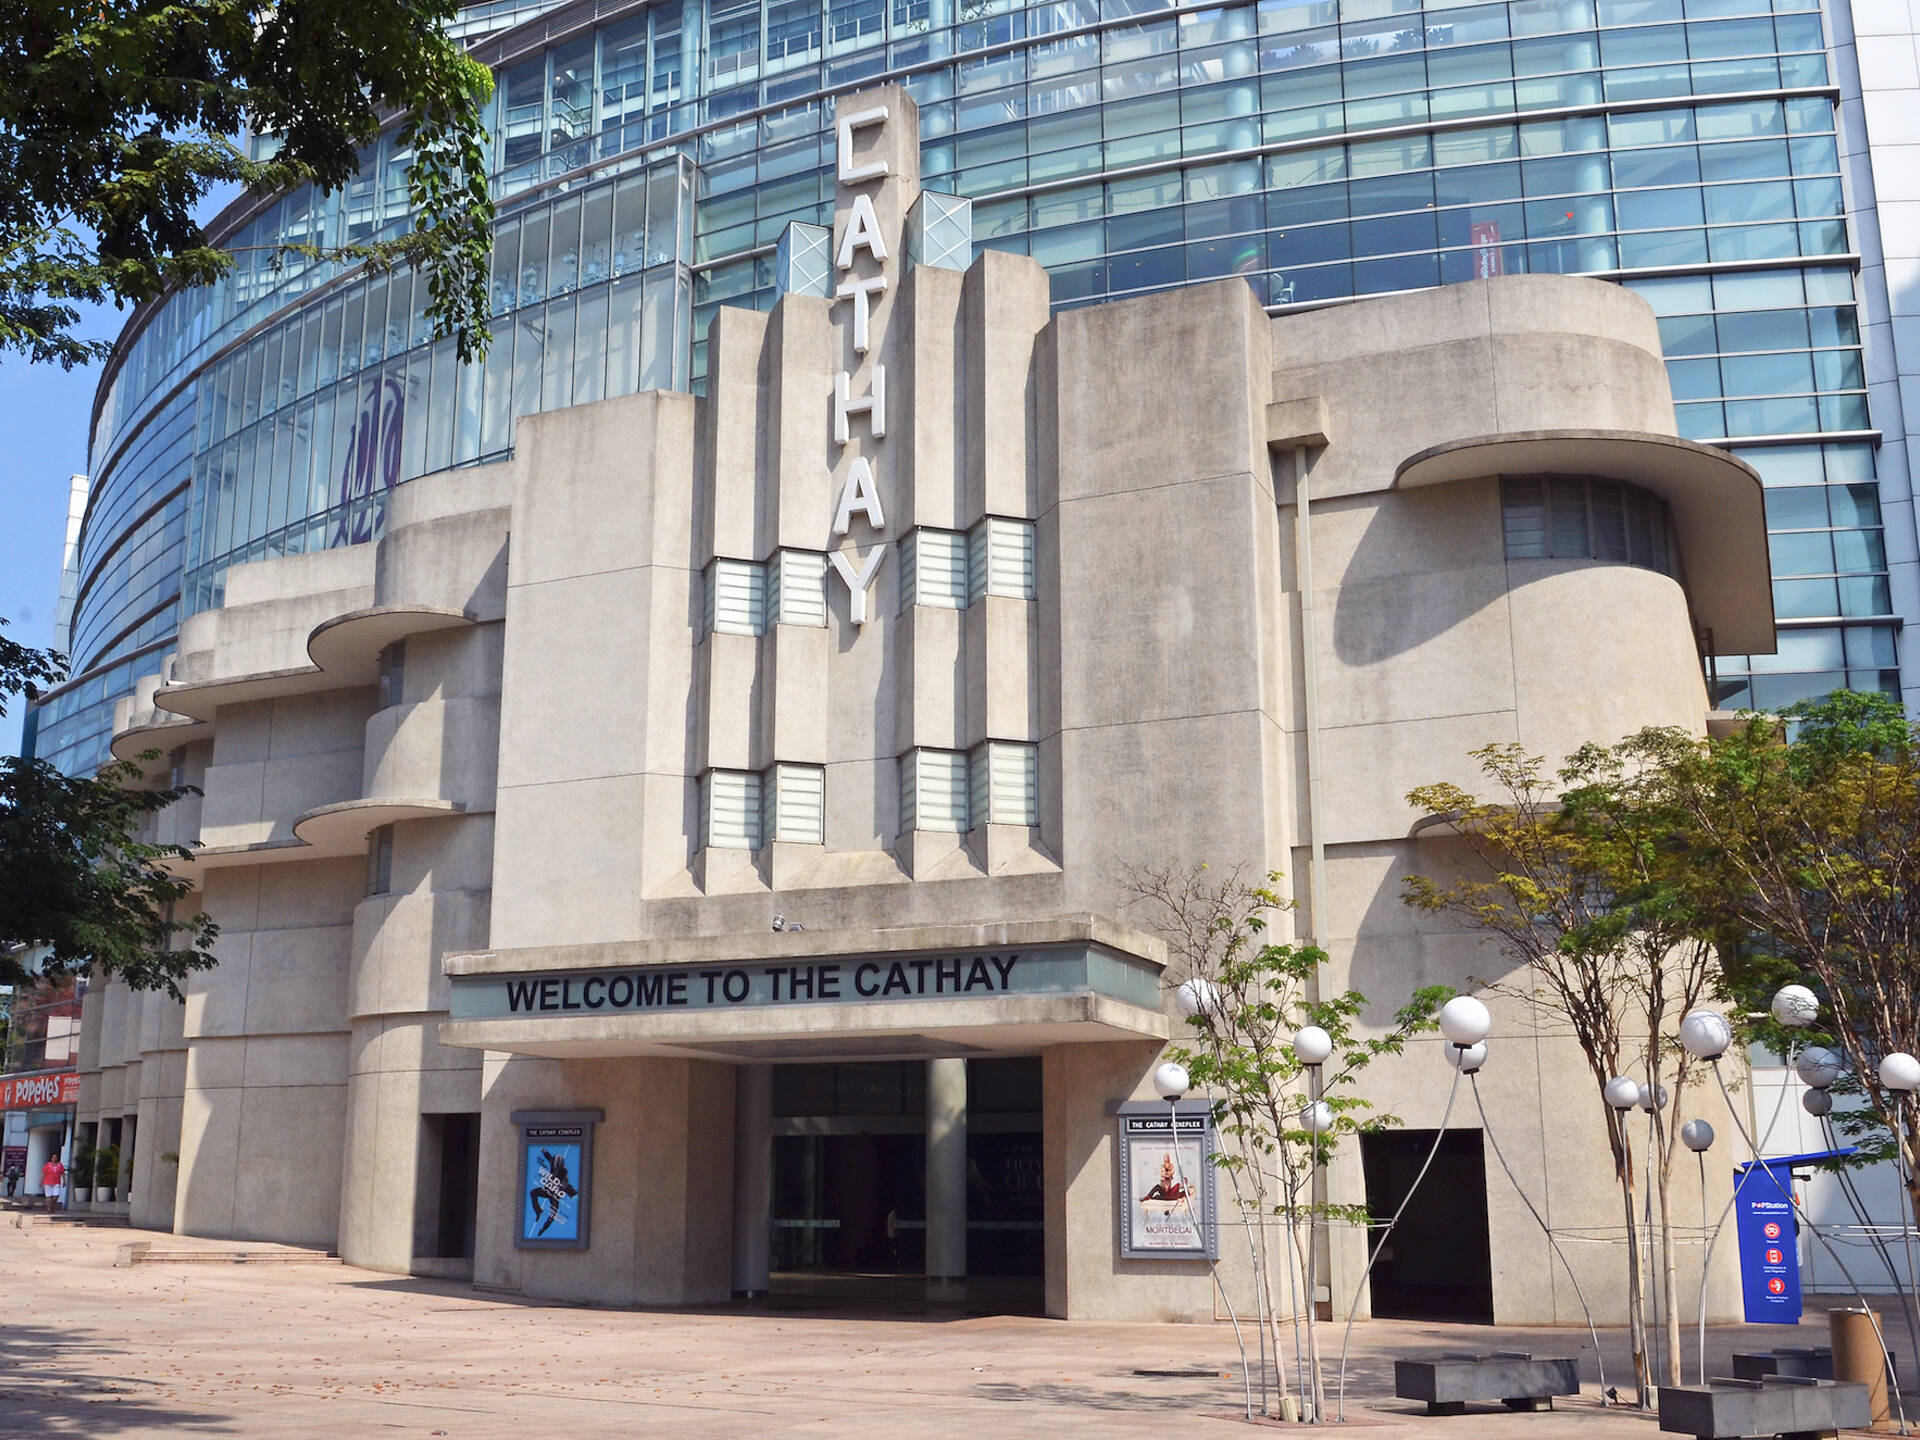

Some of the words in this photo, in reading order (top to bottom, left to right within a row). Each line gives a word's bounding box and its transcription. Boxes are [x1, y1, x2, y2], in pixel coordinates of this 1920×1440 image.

[828, 105, 889, 625] CATHAY
[507, 972, 688, 1012] WELCOME
[701, 970, 750, 1004] TO
[765, 965, 841, 1001] THE
[854, 955, 1019, 997] CATHAY
[1131, 1121, 1143, 1129] THE
[1145, 1121, 1168, 1129] CATHAY
[1170, 1120, 1201, 1128] CNEPLEX
[540, 1177, 567, 1198] CARD
[1146, 1226, 1192, 1234] MORTDECAI
